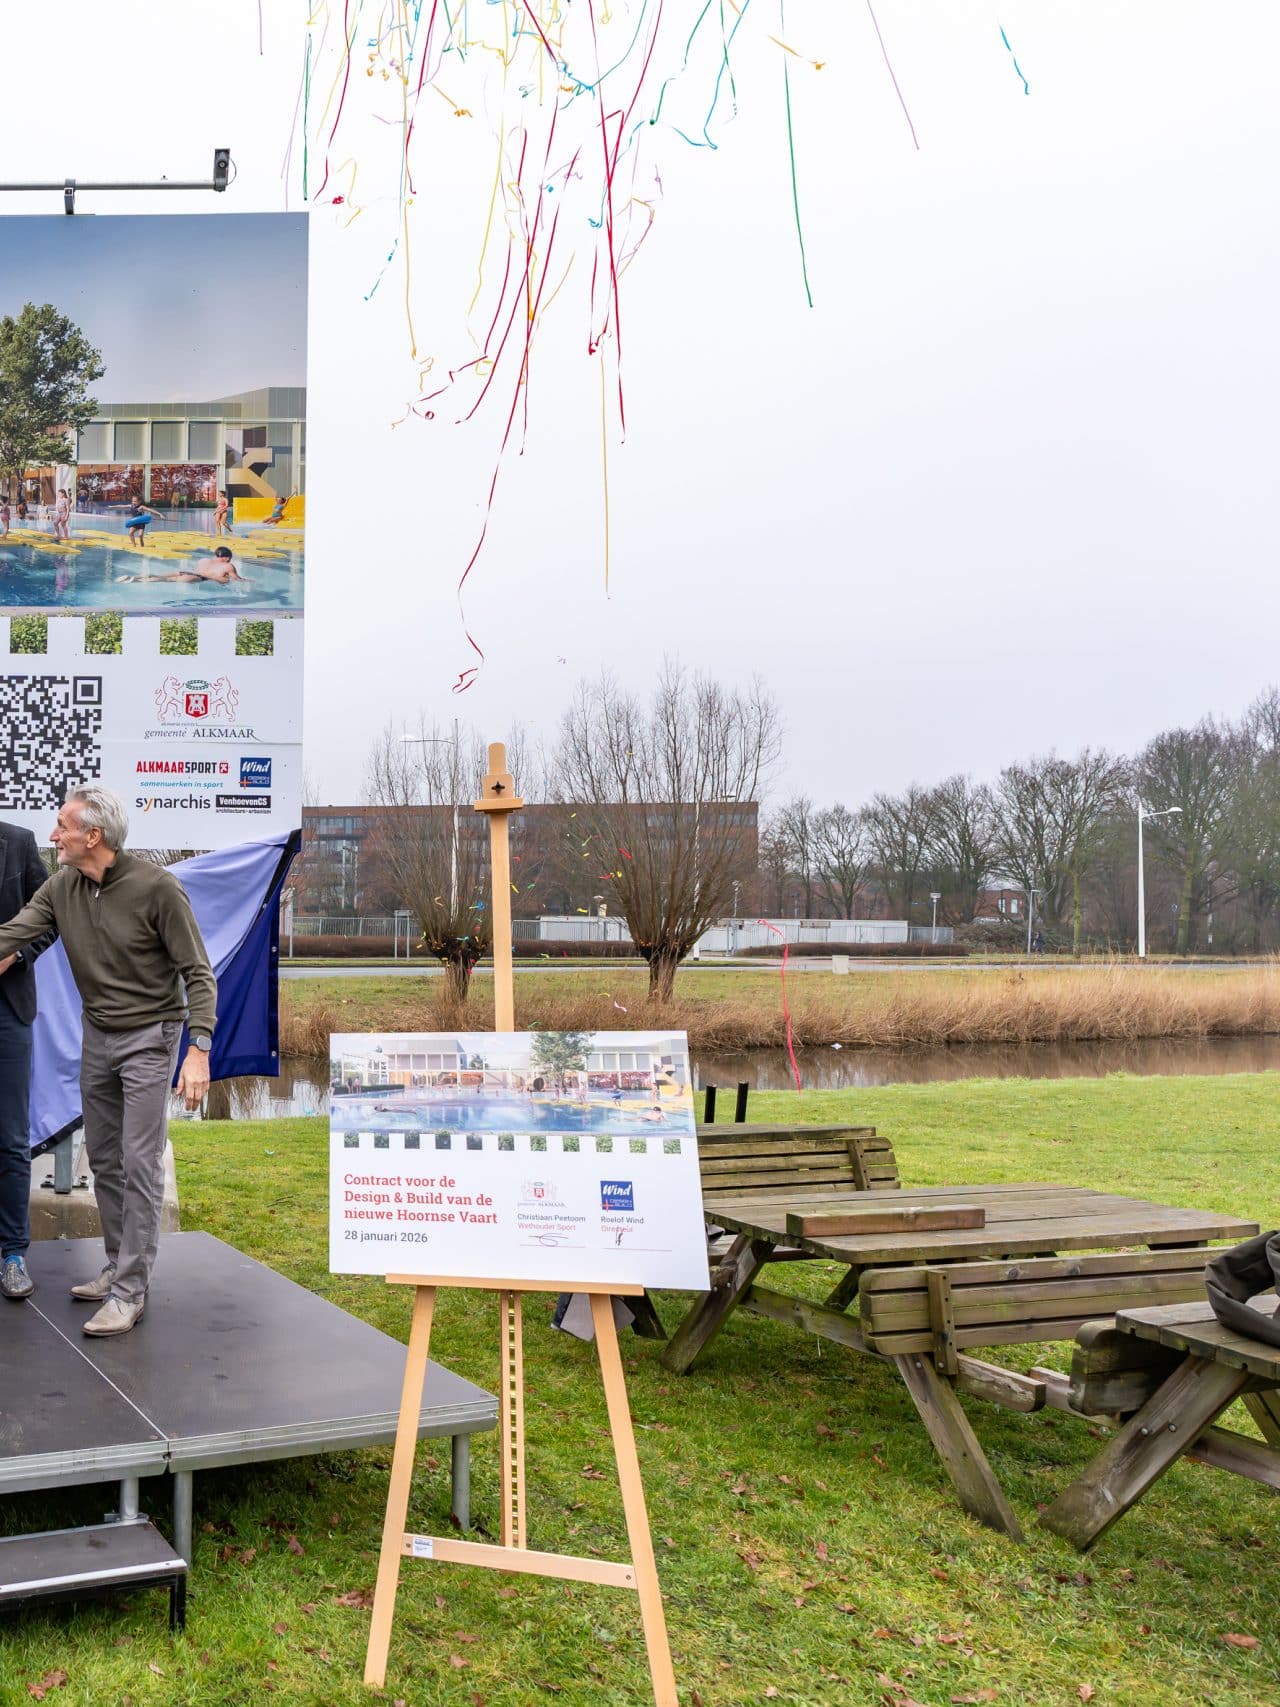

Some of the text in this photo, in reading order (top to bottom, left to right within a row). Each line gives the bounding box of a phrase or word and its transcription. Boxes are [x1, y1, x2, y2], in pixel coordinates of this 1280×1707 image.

[144, 728, 260, 742] gemeente ALKMAAR
[136, 761, 217, 773] ALKMAARSPORT
[242, 761, 270, 772] Wind
[140, 780, 223, 790] samenwerken in sport
[135, 794, 210, 811] synarchis
[344, 1174, 456, 1188] Contract voor de
[602, 1184, 631, 1195] Wind
[344, 1190, 493, 1206] Design & Build van de
[344, 1207, 498, 1224] nieuwe Hoornse Vaart
[517, 1213, 553, 1221] Christiaan
[625, 1216, 645, 1225] Wind
[557, 1223, 576, 1231] Sport
[344, 1230, 428, 1243] 28 januari 2026
